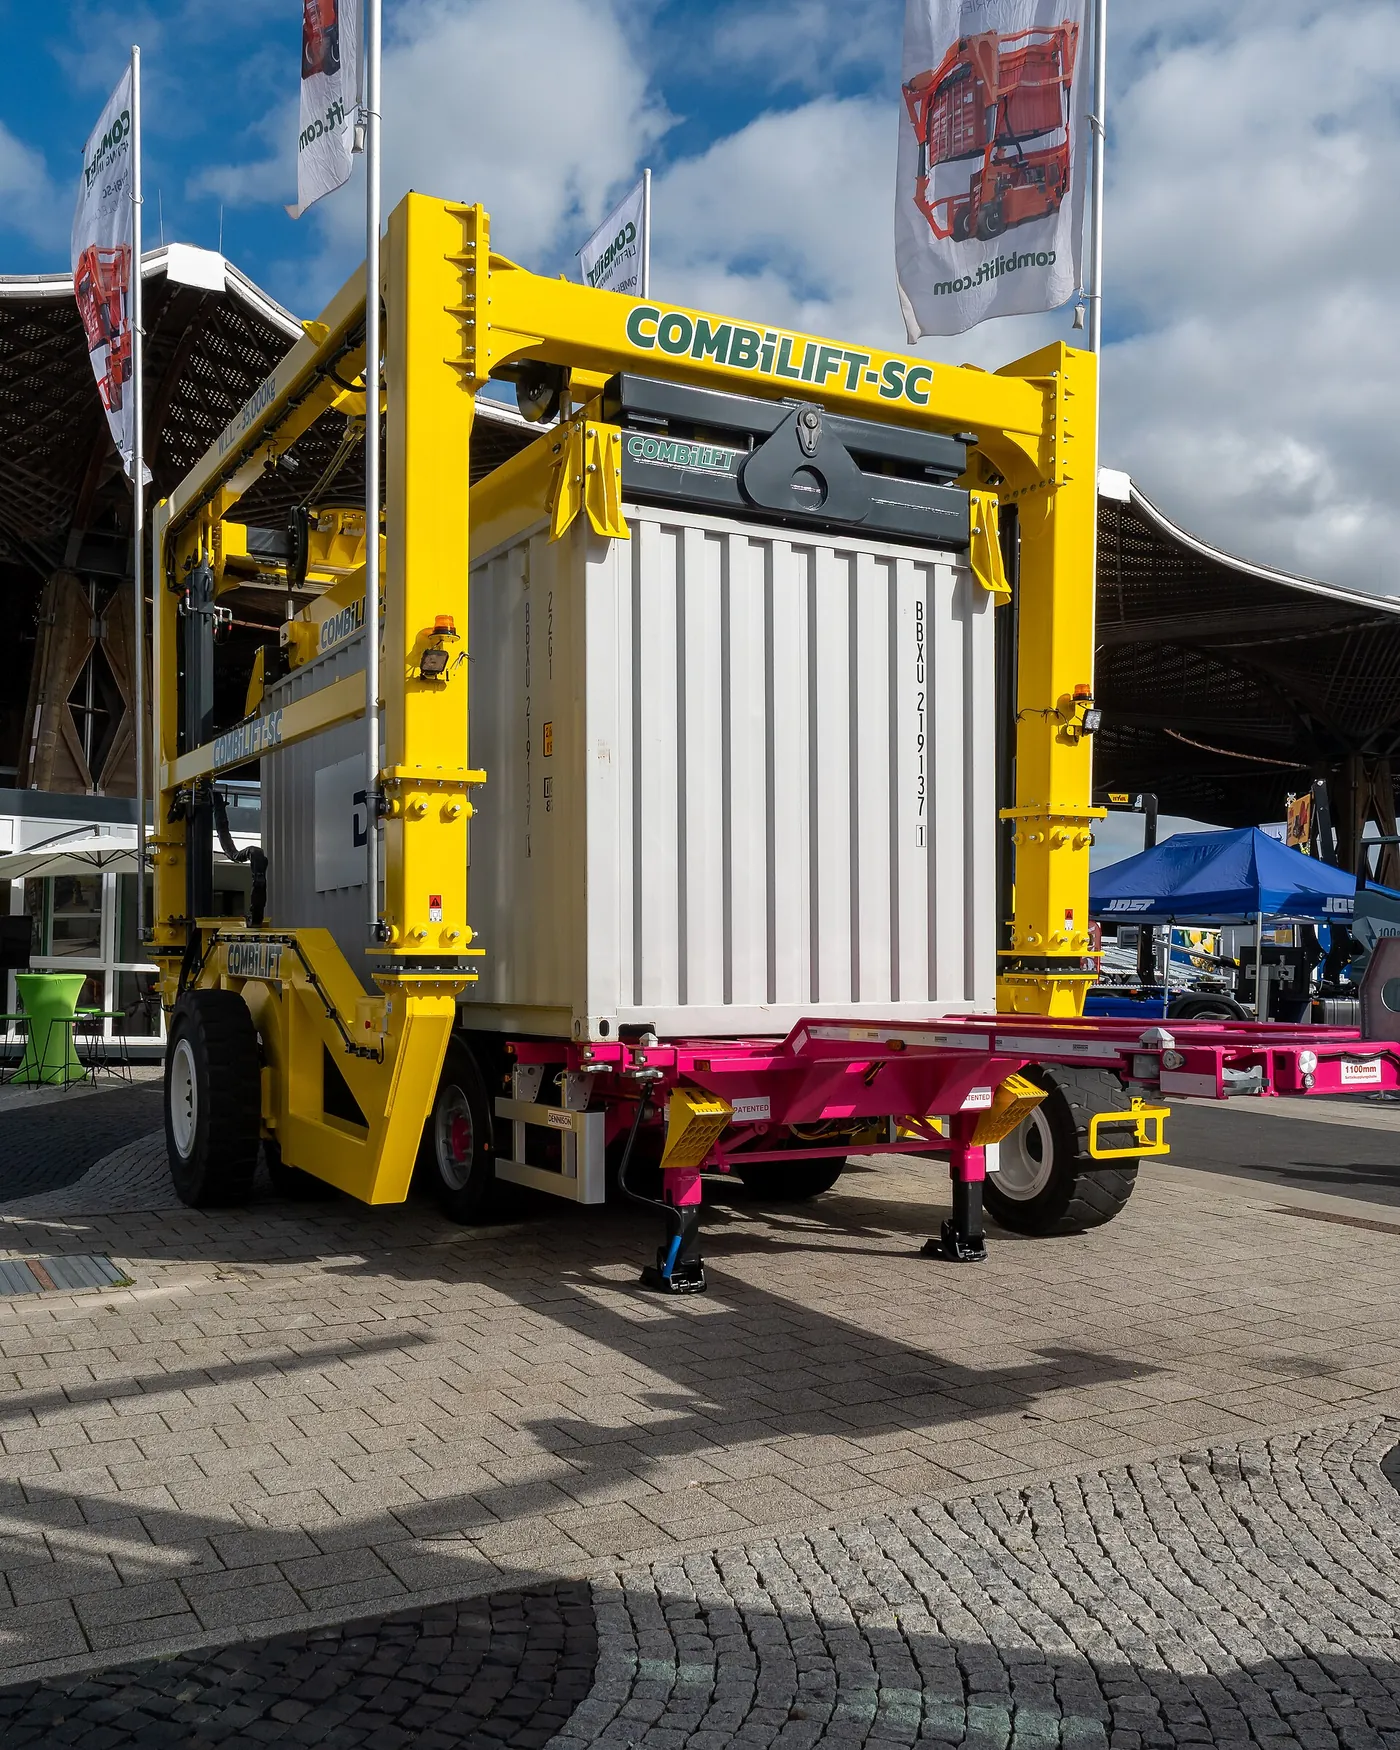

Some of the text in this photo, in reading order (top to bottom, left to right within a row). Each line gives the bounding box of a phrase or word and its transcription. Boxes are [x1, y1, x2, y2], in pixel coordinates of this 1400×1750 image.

[626, 306, 933, 405] COMBiLIFT-SC
[916, 600, 924, 684] BBXU
[917, 692, 925, 816] 219137
[1102, 899, 1155, 911] JOST
[1345, 1065, 1377, 1074] 1100mm
[733, 1104, 770, 1114] PATENTED
